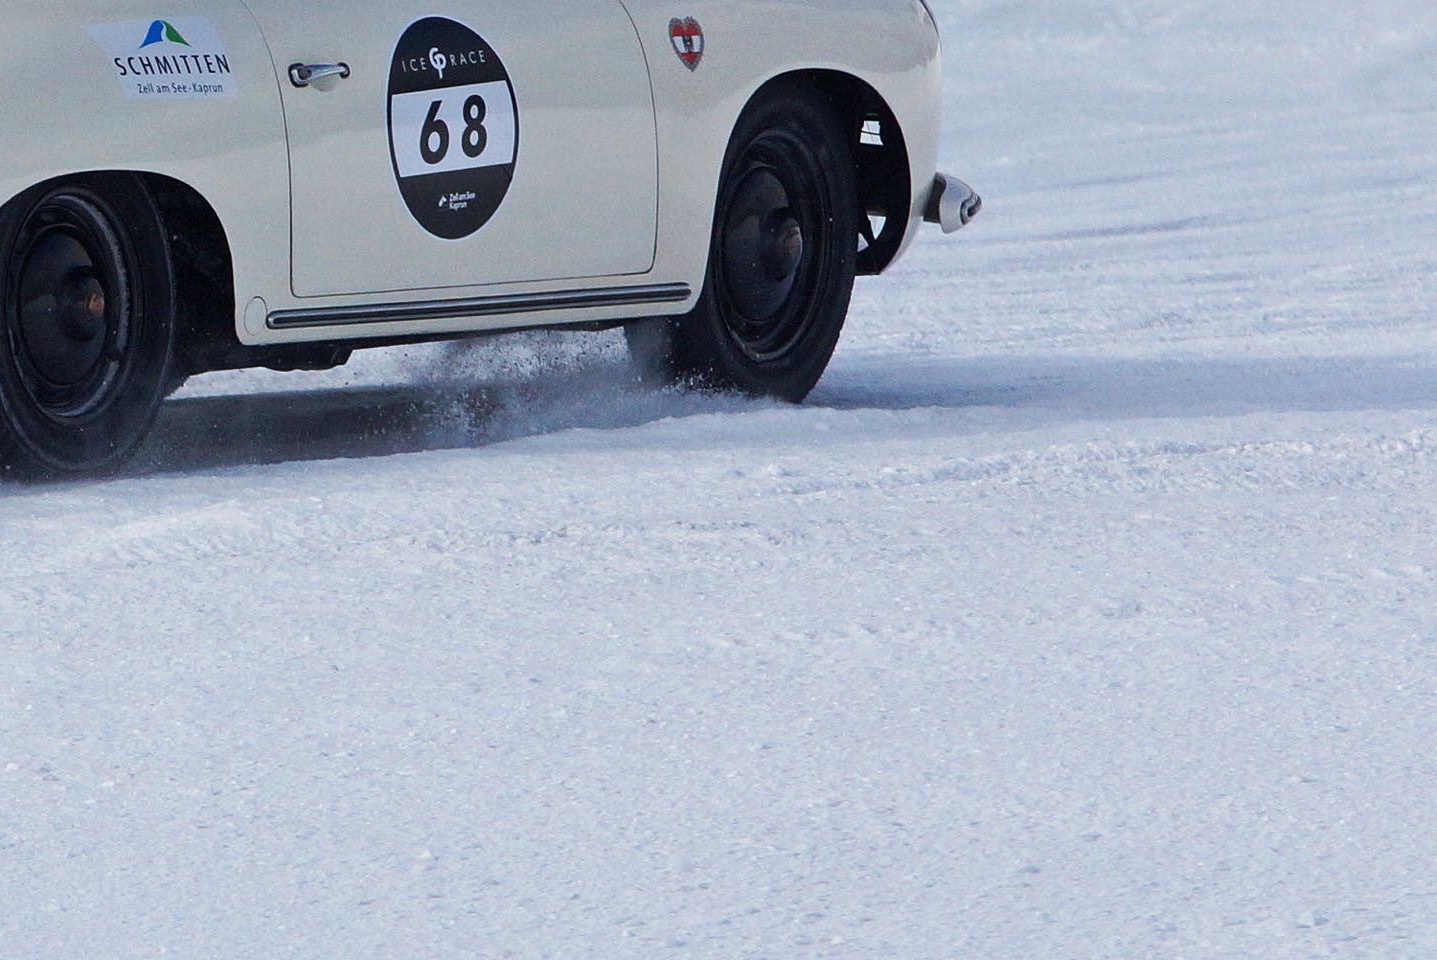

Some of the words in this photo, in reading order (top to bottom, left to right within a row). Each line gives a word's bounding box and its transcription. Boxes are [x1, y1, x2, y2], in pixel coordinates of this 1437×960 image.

[114, 54, 231, 76] SCHMITTEN
[402, 57, 427, 73] ICE
[450, 50, 486, 67] RACE
[137, 83, 153, 94] Zell
[156, 85, 170, 94] am
[419, 94, 487, 165] 68
